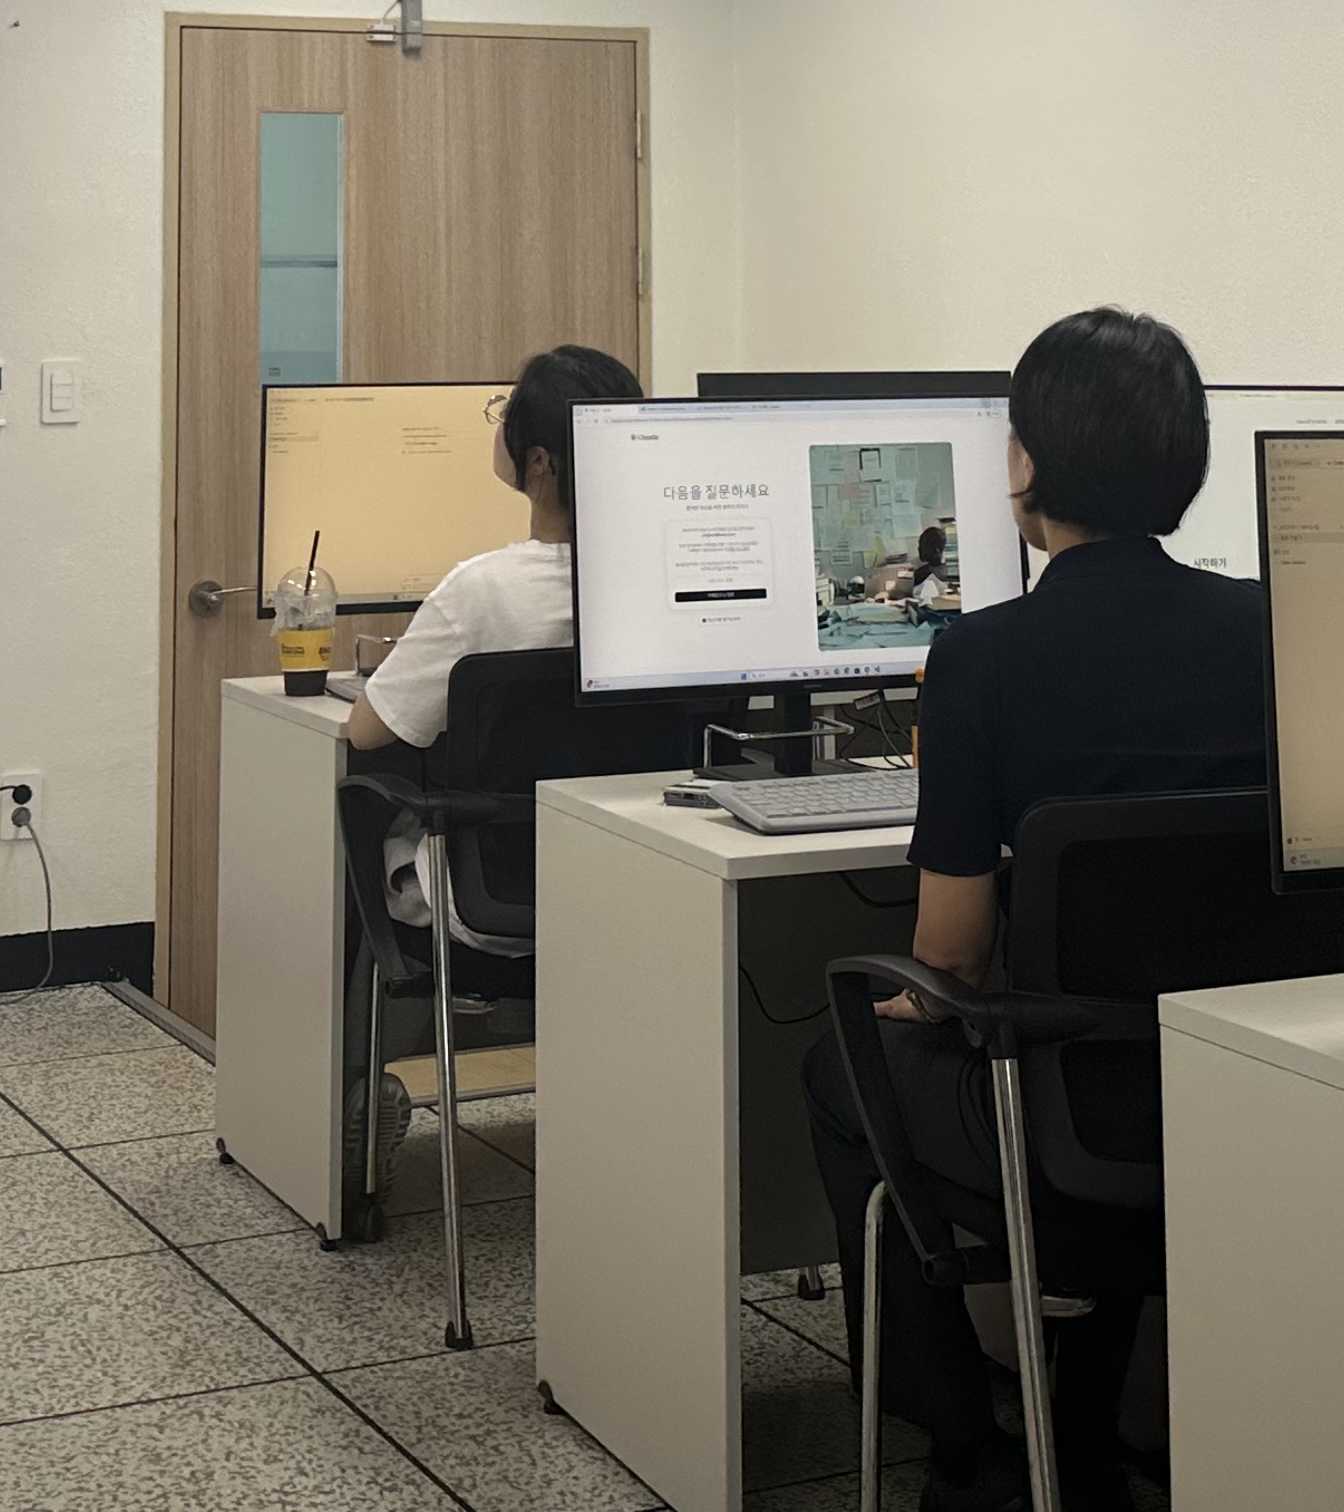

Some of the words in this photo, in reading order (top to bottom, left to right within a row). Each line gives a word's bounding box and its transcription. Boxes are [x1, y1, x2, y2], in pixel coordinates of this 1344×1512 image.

[663, 485, 702, 502] 다음을
[705, 484, 770, 501] 질문하세요
[1193, 556, 1227, 569] 시작하기
